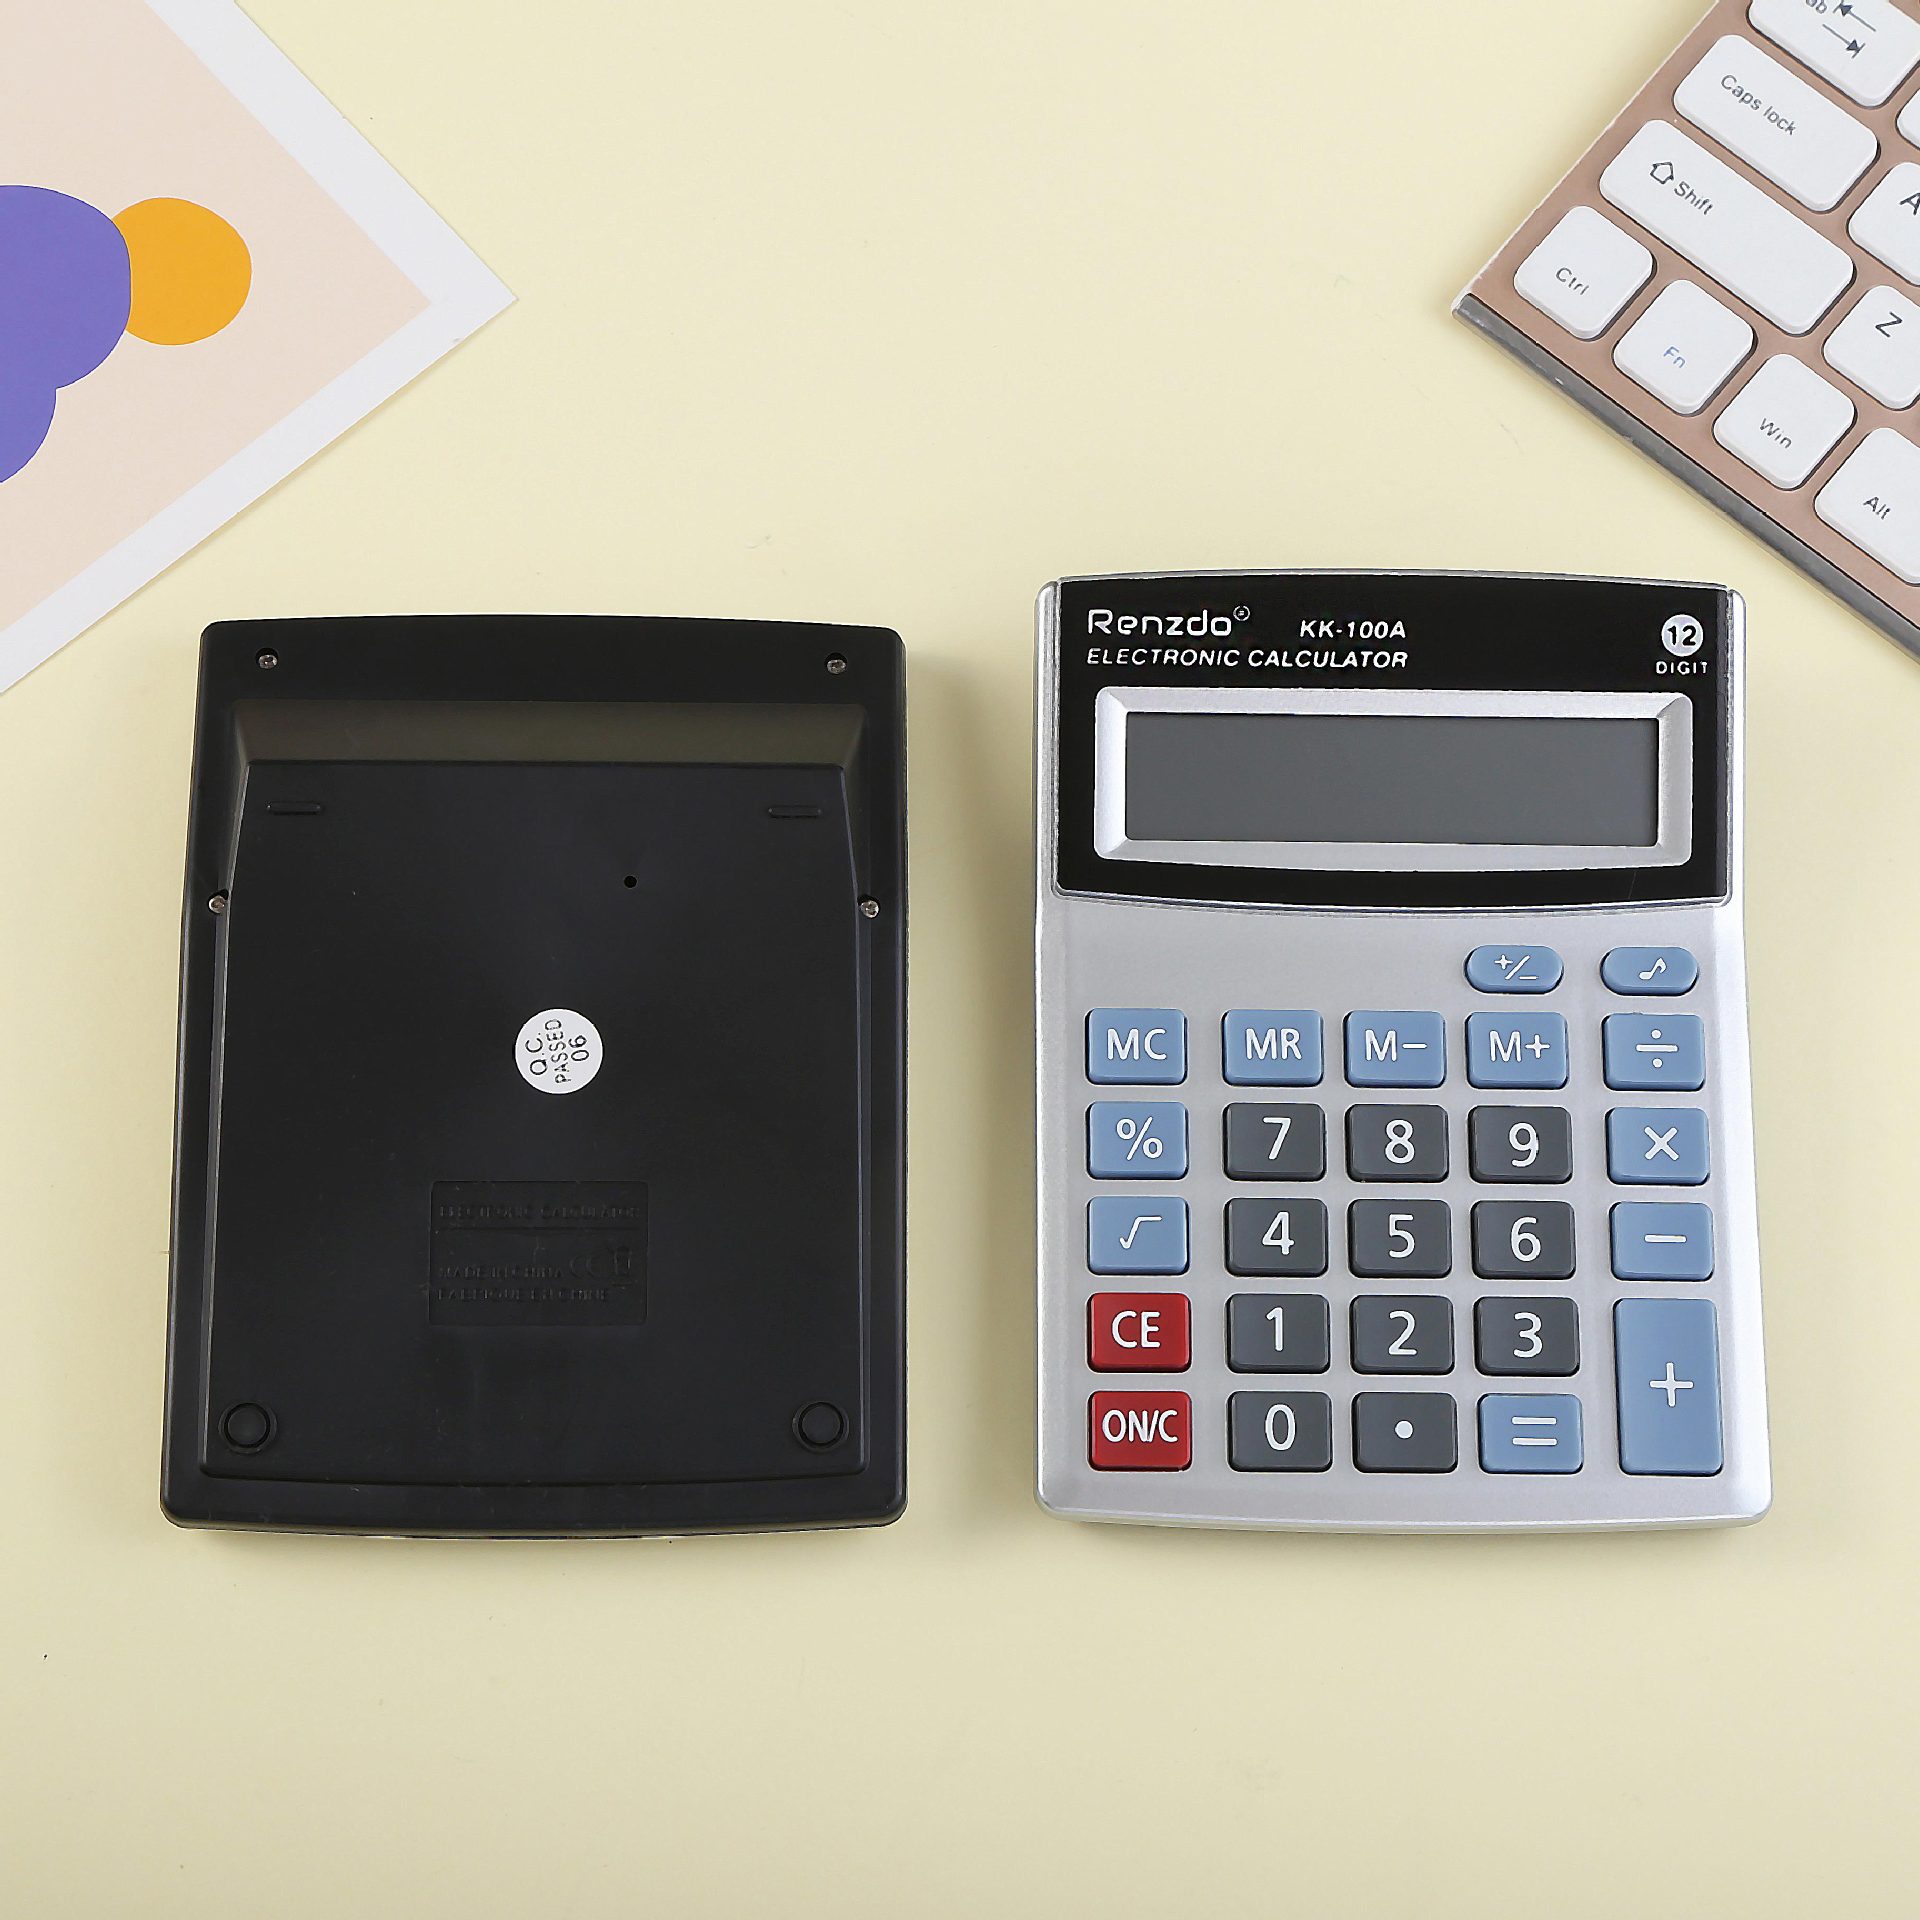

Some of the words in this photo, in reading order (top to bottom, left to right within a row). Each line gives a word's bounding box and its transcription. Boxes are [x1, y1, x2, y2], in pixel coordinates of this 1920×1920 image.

[1720, 75, 1763, 111] Caps
[1763, 105, 1797, 136] lock
[1674, 180, 1714, 216] Shift
[1555, 266, 1590, 296] Ctrl
[1875, 311, 1903, 338] Z
[1663, 345, 1686, 368] Fn
[1759, 416, 1793, 450] Win
[1862, 496, 1891, 520] Alt
[1299, 619, 1407, 639] KK-100A
[1667, 624, 1697, 646] 12
[1087, 647, 1241, 667] ELECTRONIC
[1247, 649, 1408, 668] CALCULATOR
[1655, 660, 1708, 675] DIGIT
[545, 1019, 571, 1084] PASSED
[568, 1035, 589, 1061] 06
[1107, 1028, 1167, 1060] MC
[1246, 1028, 1302, 1060] MR
[1489, 1030, 1550, 1062] M+
[1116, 1116, 1163, 1160] %
[1263, 1116, 1291, 1160] 7
[1384, 1120, 1415, 1164] 8
[1508, 1122, 1539, 1167] 9
[1262, 1211, 1295, 1255] 4
[1388, 1214, 1415, 1258] 5
[1510, 1216, 1541, 1262] 6
[1111, 1311, 1160, 1348] CE
[1266, 1307, 1283, 1351] 1
[1388, 1311, 1417, 1355] 2
[1513, 1312, 1543, 1358] 3
[1101, 1409, 1178, 1442] ON/C
[1264, 1404, 1296, 1451] 0
